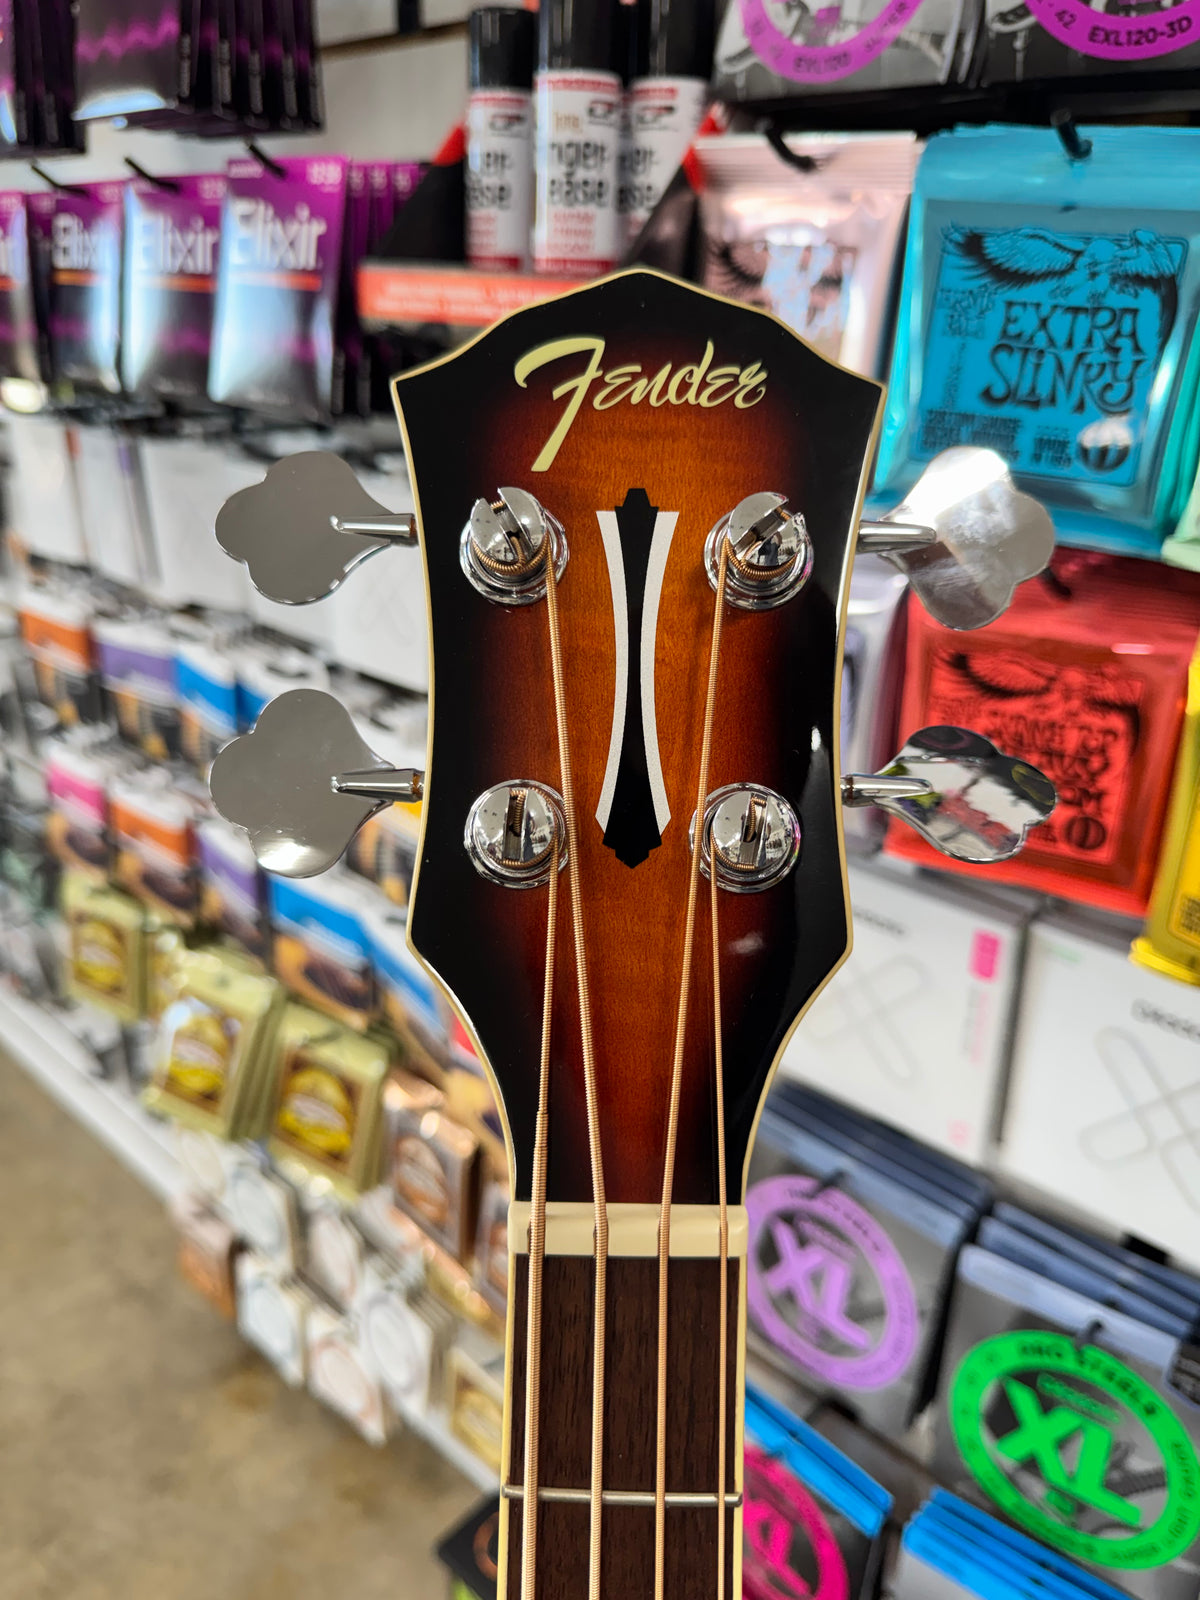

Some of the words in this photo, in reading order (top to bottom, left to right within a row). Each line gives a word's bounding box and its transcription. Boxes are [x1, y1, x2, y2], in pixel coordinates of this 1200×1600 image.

[1088, 15, 1193, 47] EXL120-3D
[231, 198, 328, 272] Elixir
[997, 300, 1146, 357] EXTRA
[514, 336, 768, 472] Fender
[980, 343, 1146, 416] SLINKY
[766, 1219, 870, 1349] XL
[996, 1375, 1142, 1526] XL
